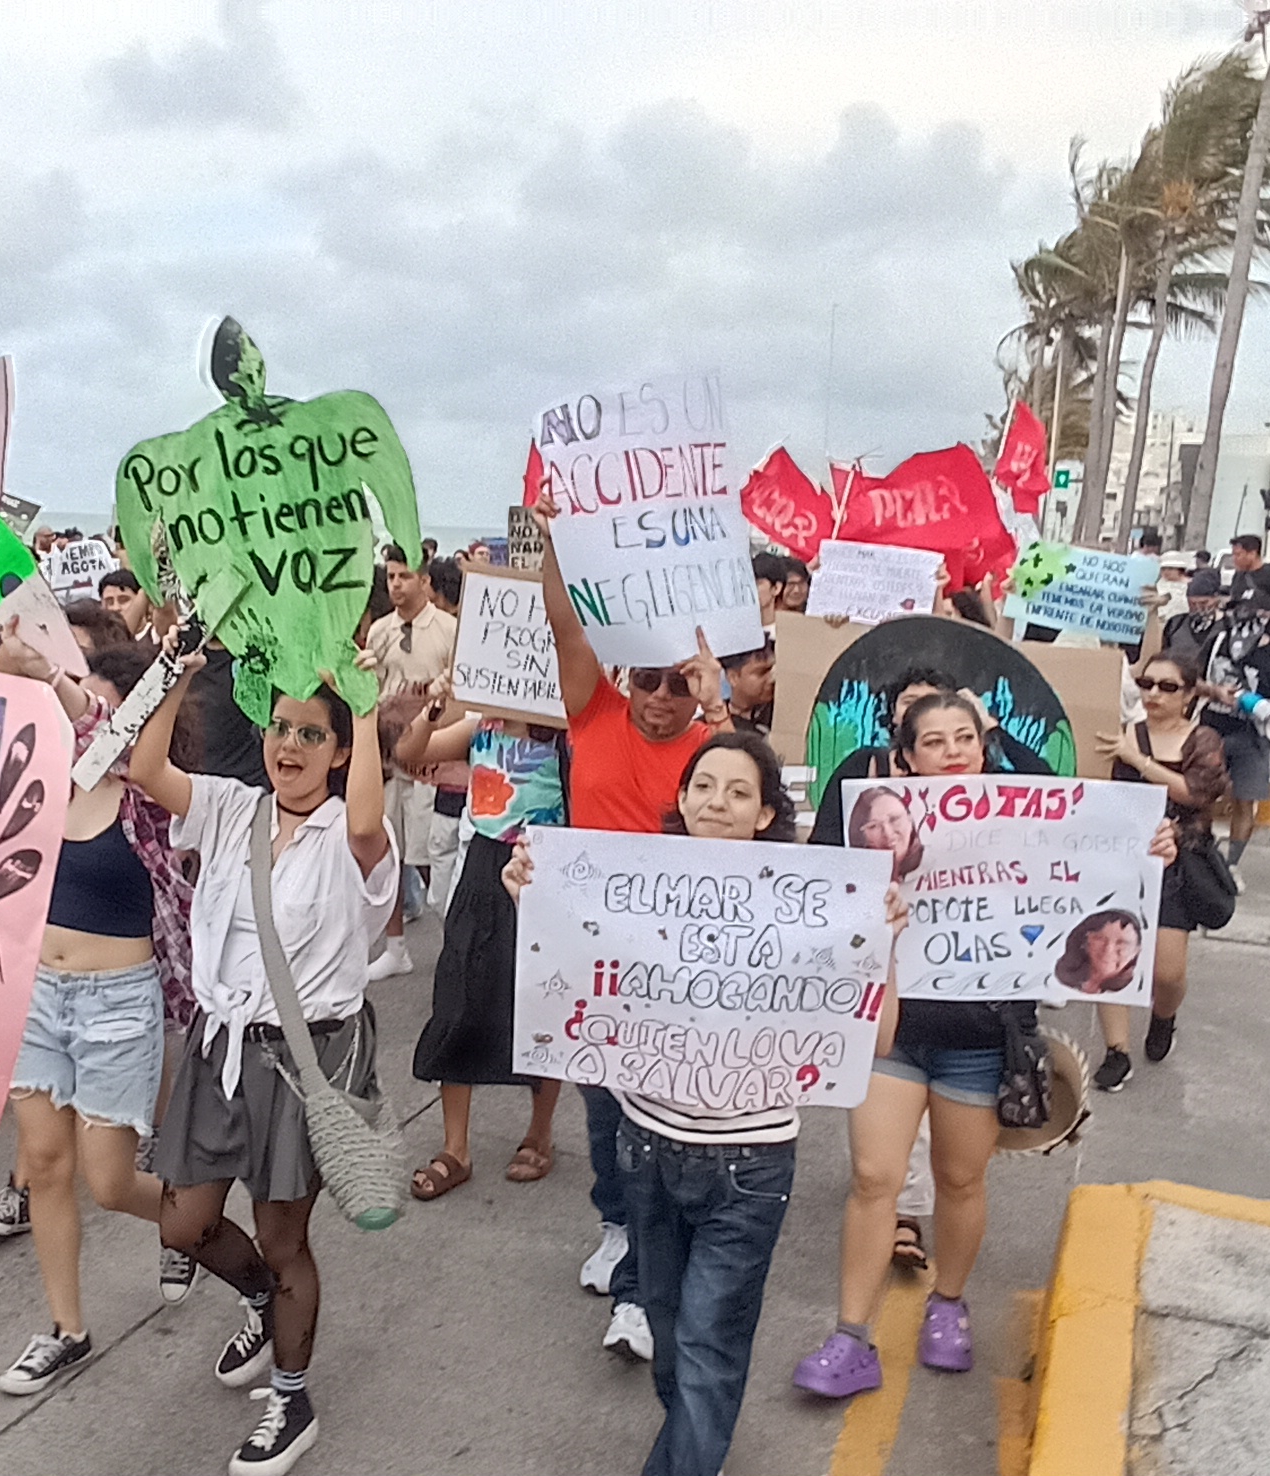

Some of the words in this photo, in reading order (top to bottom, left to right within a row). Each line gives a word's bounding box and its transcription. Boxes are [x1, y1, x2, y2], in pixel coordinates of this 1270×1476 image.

[540, 394, 603, 447] NO
[619, 382, 669, 437] ES
[682, 375, 723, 433] UN
[124, 453, 203, 512] Por
[214, 426, 283, 480] los
[288, 425, 378, 491] que
[549, 442, 727, 516] ACCIDENTE
[168, 507, 225, 550] no
[229, 486, 371, 541] tienen
[612, 510, 666, 549] ES
[672, 507, 726, 546] UNA
[61, 559, 106, 575] AGOTA
[1082, 555, 1098, 566] NO
[1103, 559, 1127, 574] NOS
[479, 585, 519, 619] NO
[568, 556, 756, 628] NEGLIGENCIA
[1042, 591, 1084, 608] TENEMOS
[1089, 601, 1103, 616] LA
[1081, 615, 1093, 628] DE
[506, 650, 551, 678] SIN
[946, 829, 1003, 852] DICE
[1023, 831, 1049, 855] LA
[1063, 836, 1142, 857] GOBER
[915, 860, 1028, 892] MIENTRAS
[1050, 861, 1081, 883] EL
[654, 872, 755, 923] MAR
[773, 873, 831, 928] SE
[1014, 896, 1083, 915] LLEGA
[679, 923, 783, 969] ESTA
[721, 1027, 776, 1069] LO
[779, 1030, 846, 1069] VA
[565, 1044, 606, 1087] A
[617, 1052, 820, 1111] SALVAR?
